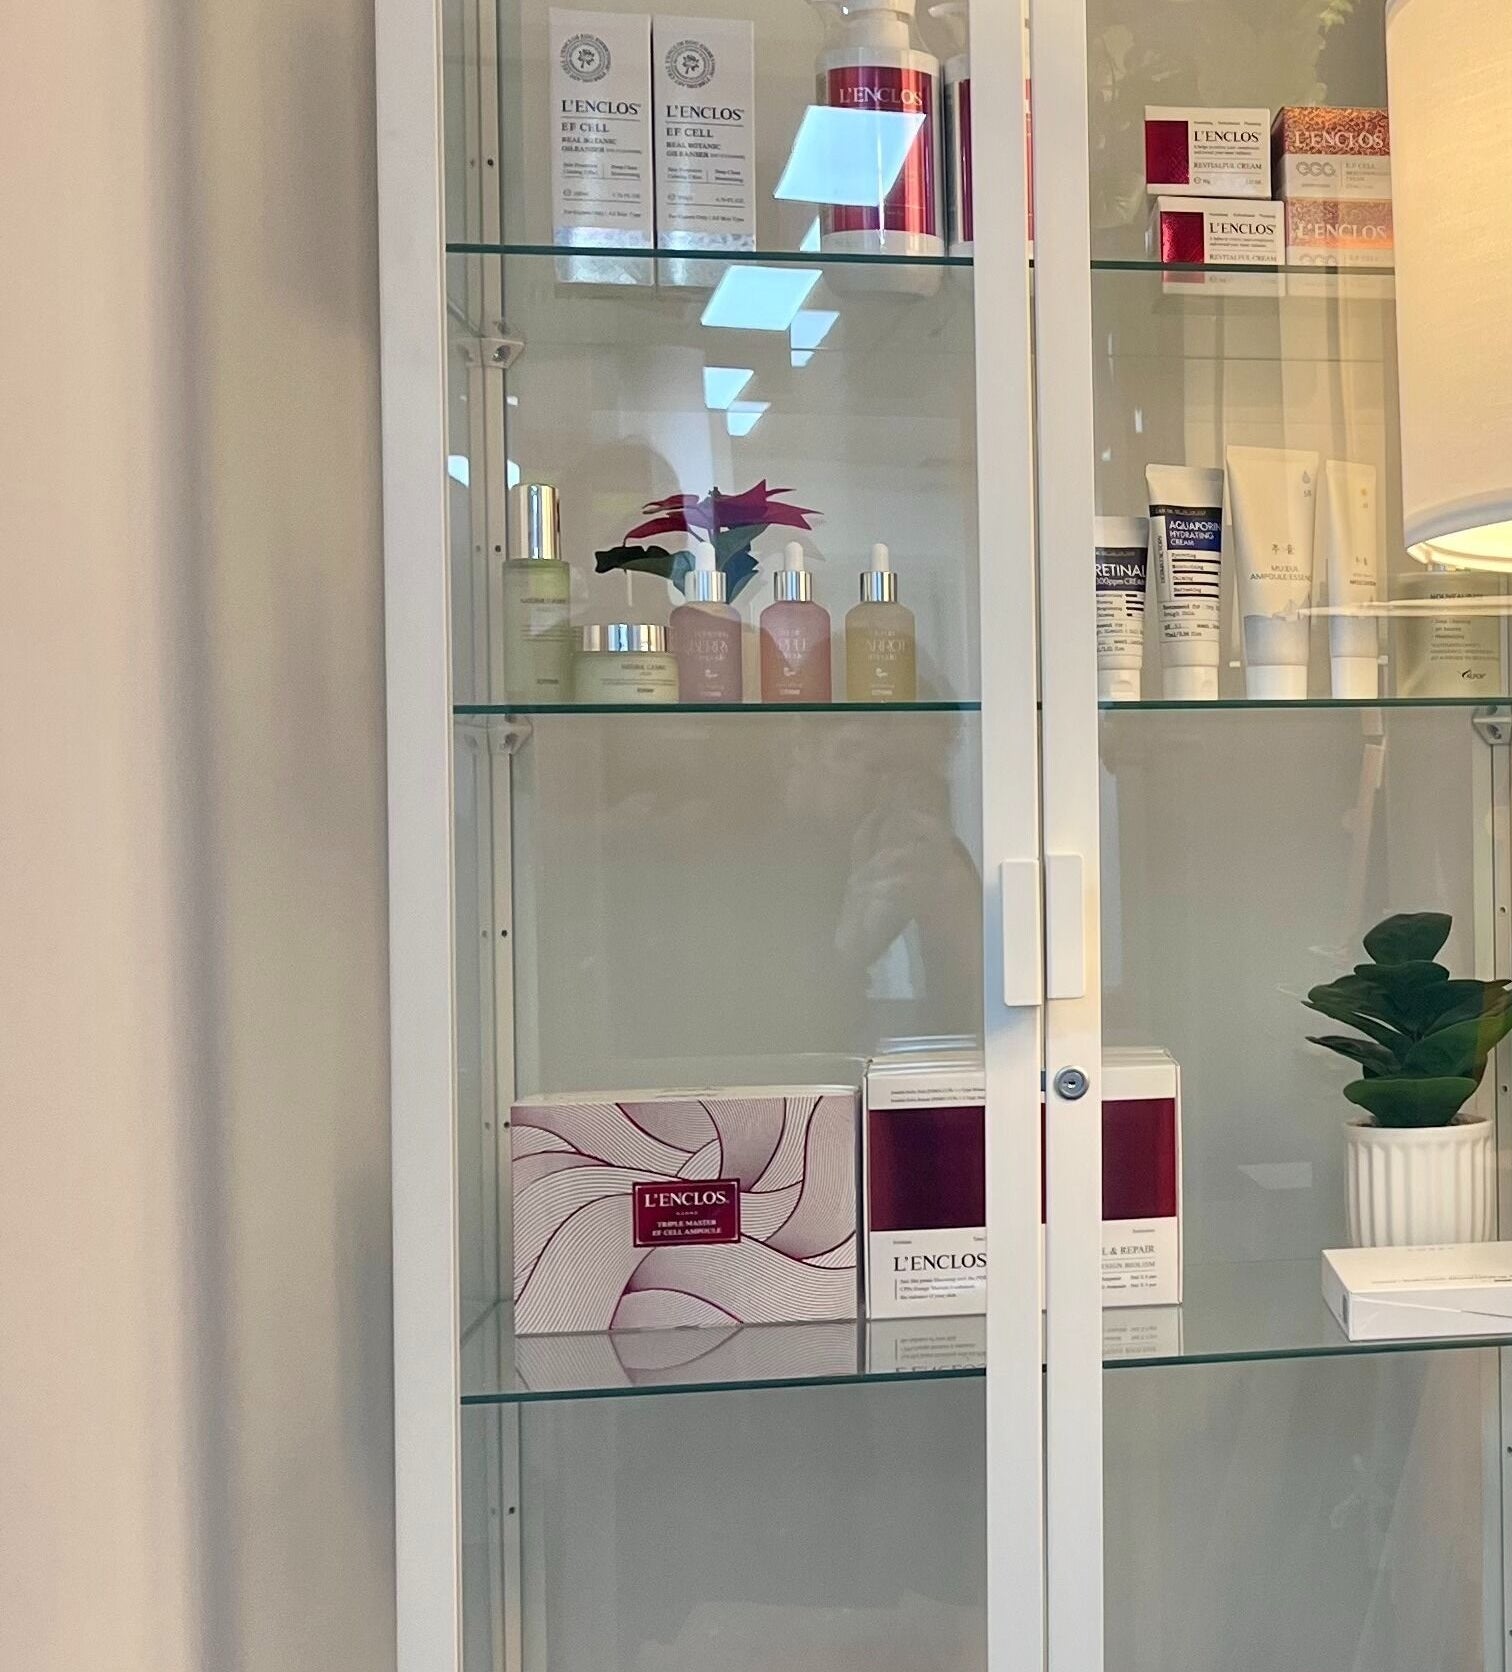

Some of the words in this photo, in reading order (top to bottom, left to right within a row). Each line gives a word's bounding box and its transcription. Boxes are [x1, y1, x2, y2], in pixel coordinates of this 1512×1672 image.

[840, 87, 923, 105] L'ENCLOS
[562, 99, 638, 115] L'ENCLOS
[666, 105, 742, 121] L'ENCLOS
[684, 128, 714, 138] CELL
[1194, 131, 1259, 143] L'ENCLOS
[1237, 162, 1262, 170] CREAM
[1209, 223, 1274, 235] L'ENCLOS
[1296, 223, 1387, 240] L'ENCLOS
[1170, 530, 1215, 540] HYDRATING
[1170, 538, 1194, 547] CREAM
[1095, 563, 1146, 578] RETINAL
[644, 1191, 728, 1208] L'ENCLOS
[1120, 1245, 1155, 1255] REPAIR
[894, 1253, 987, 1272] L'ENCLOS
